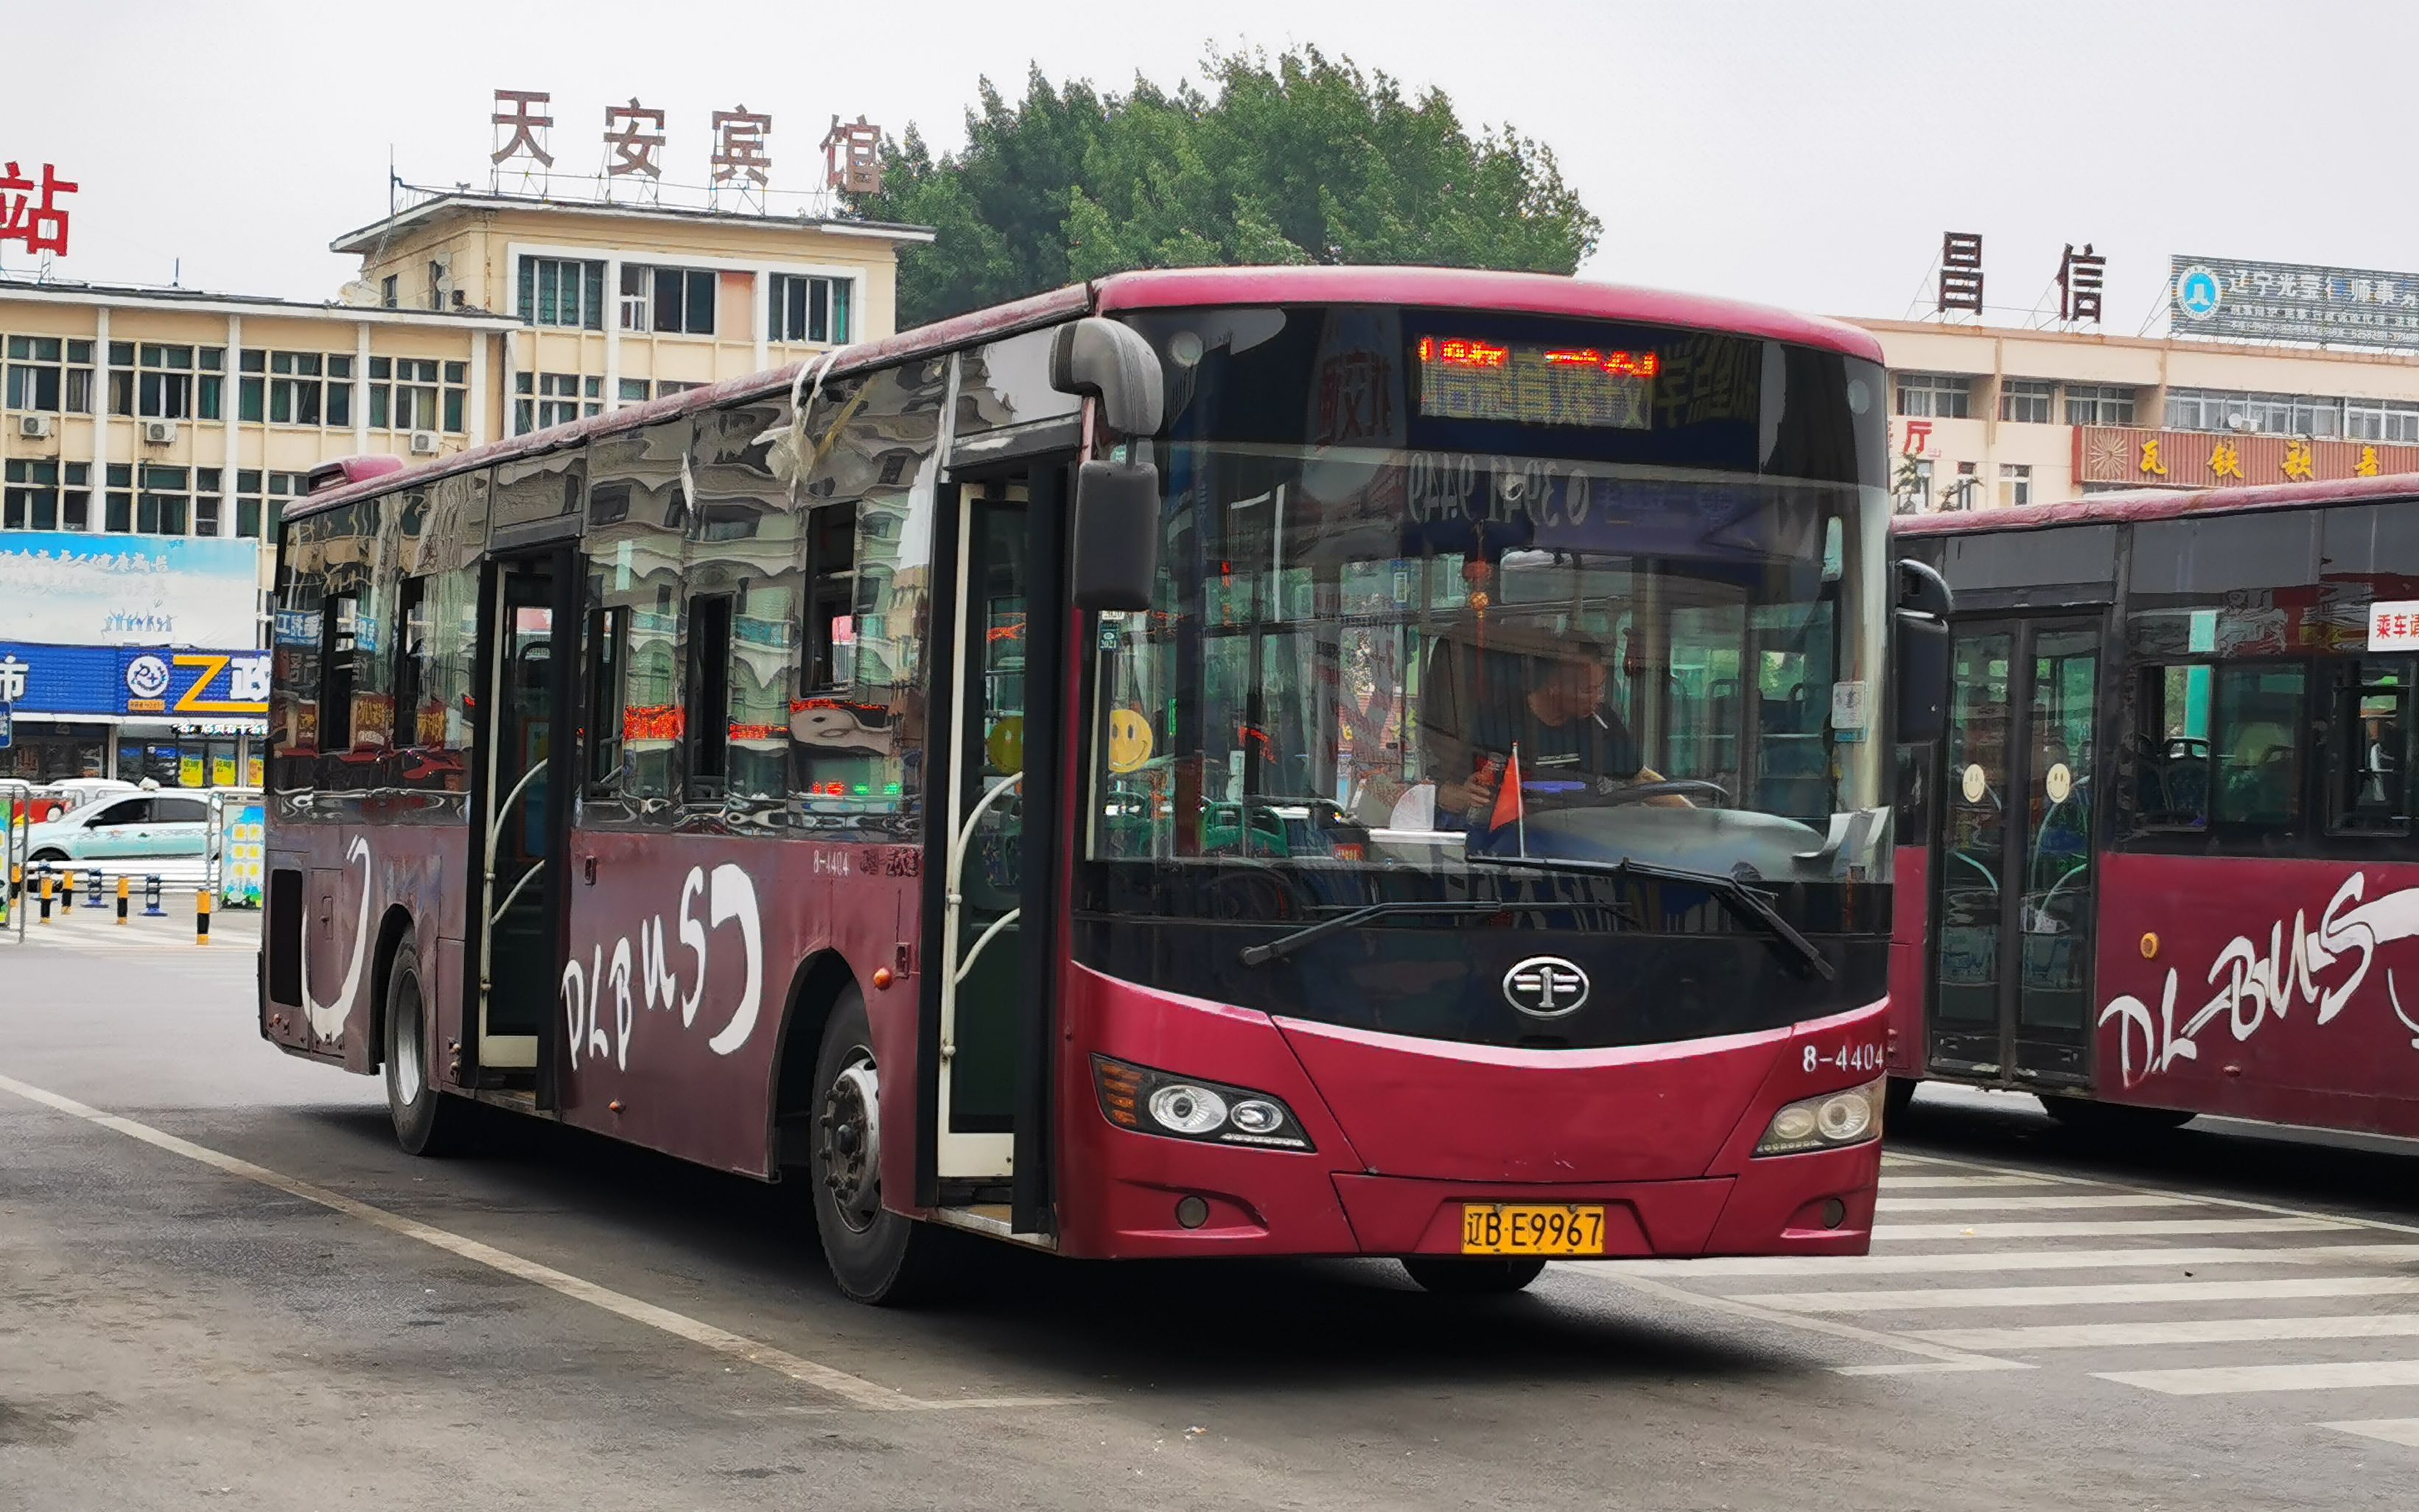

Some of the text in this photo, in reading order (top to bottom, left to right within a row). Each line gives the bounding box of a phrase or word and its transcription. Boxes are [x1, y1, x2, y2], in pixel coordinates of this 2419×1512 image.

[491, 89, 882, 194] 天安宾馆
[0, 161, 78, 256] 站
[1939, 231, 2107, 323] 昌信
[1100, 640, 1117, 649] 2021
[1803, 1043, 1884, 1072] 8-4404
